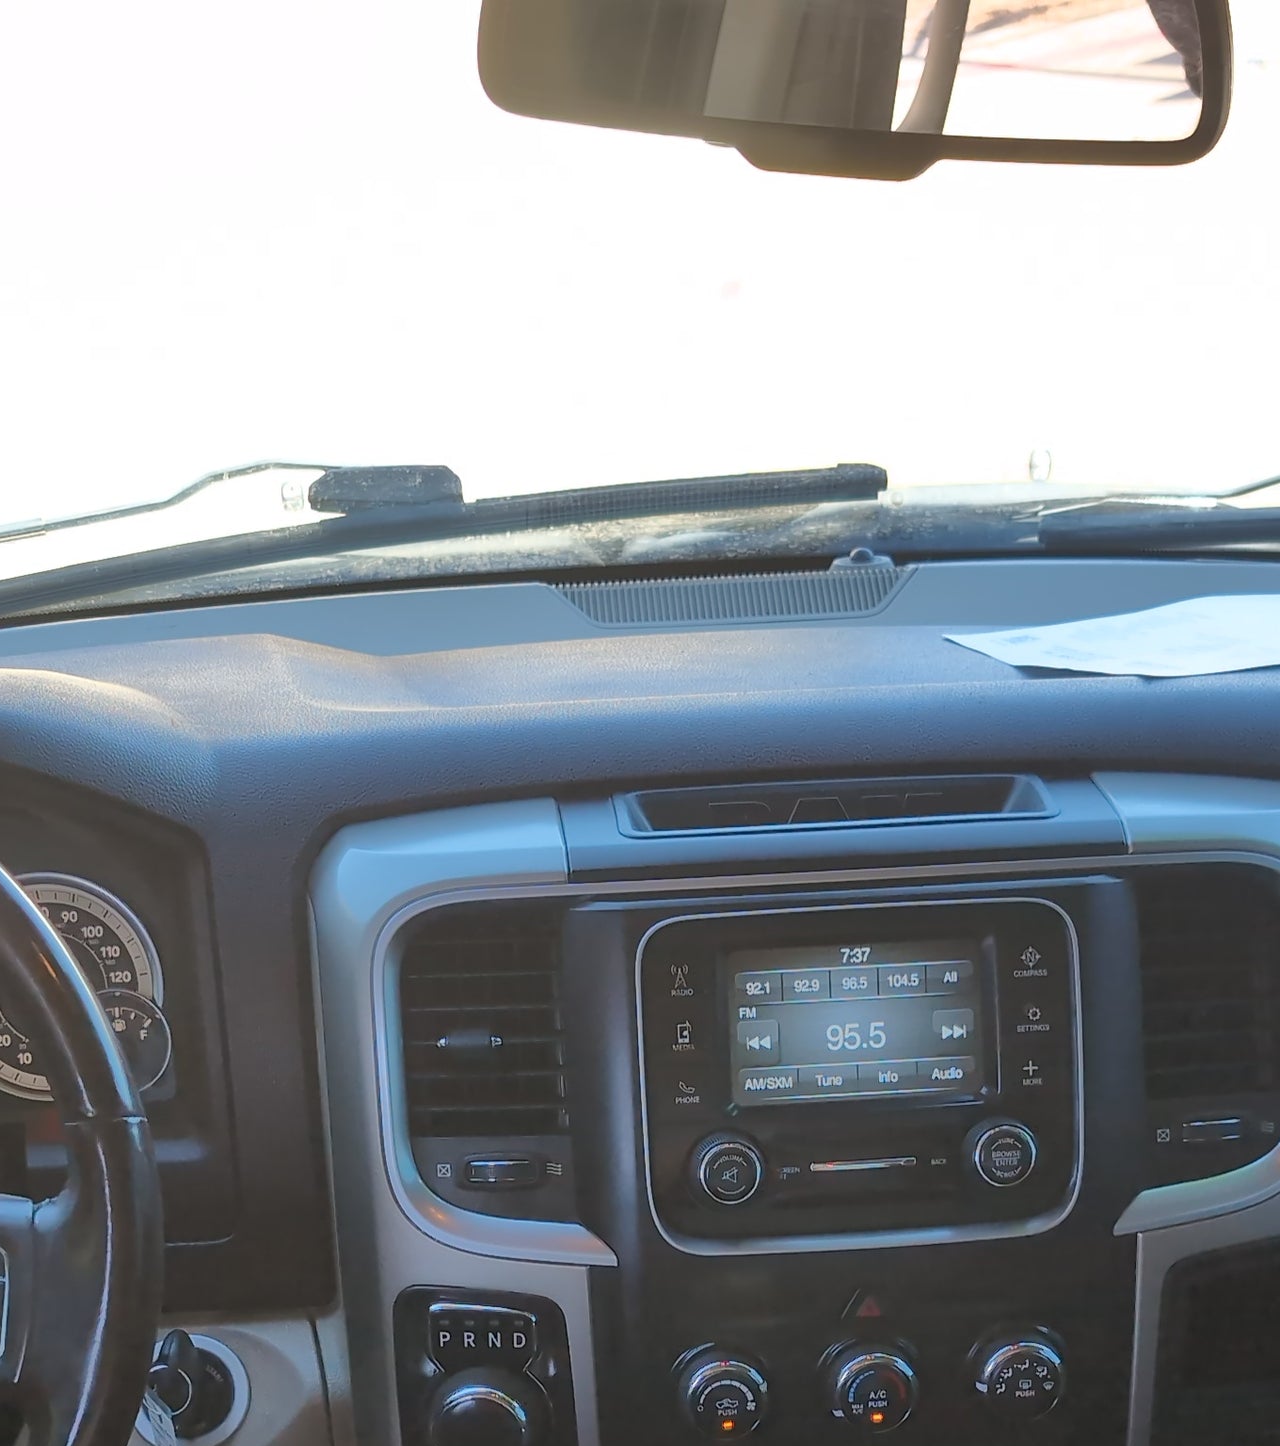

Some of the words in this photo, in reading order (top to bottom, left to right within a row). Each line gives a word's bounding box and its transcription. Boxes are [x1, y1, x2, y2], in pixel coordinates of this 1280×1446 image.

[61, 911, 78, 923] 90
[81, 925, 103, 938] 100
[100, 946, 120, 958] 110
[840, 947, 871, 964] 7:37
[109, 970, 132, 983] 120
[1013, 968, 1048, 978] COMPASS
[745, 981, 771, 996] 92.1
[793, 979, 820, 993] 92.9
[841, 977, 868, 990] 96.5
[887, 973, 919, 988] 104.5
[943, 971, 958, 984] All
[671, 988, 694, 997] RADIO
[739, 1007, 756, 1019] FM
[1017, 1024, 1050, 1033] SETTINGS
[139, 1029, 148, 1041] F
[826, 1022, 886, 1051] 95.5
[672, 1043, 695, 1052] MEDIA
[17, 1052, 32, 1065] 10
[744, 1077, 793, 1091] AM/SXM
[815, 1074, 843, 1087] Tune
[878, 1070, 899, 1083] Info
[931, 1067, 963, 1081] Audio
[1022, 1077, 1042, 1086] MORE
[675, 1096, 700, 1104] PHONE
[439, 1331, 451, 1347] P
[463, 1331, 475, 1348] R
[488, 1331, 502, 1348] N
[513, 1332, 526, 1348] D
[869, 1390, 887, 1400] A/C
[1015, 1390, 1036, 1398] PUSH
[868, 1400, 888, 1408] PUSH
[718, 1408, 738, 1417] PUSH
